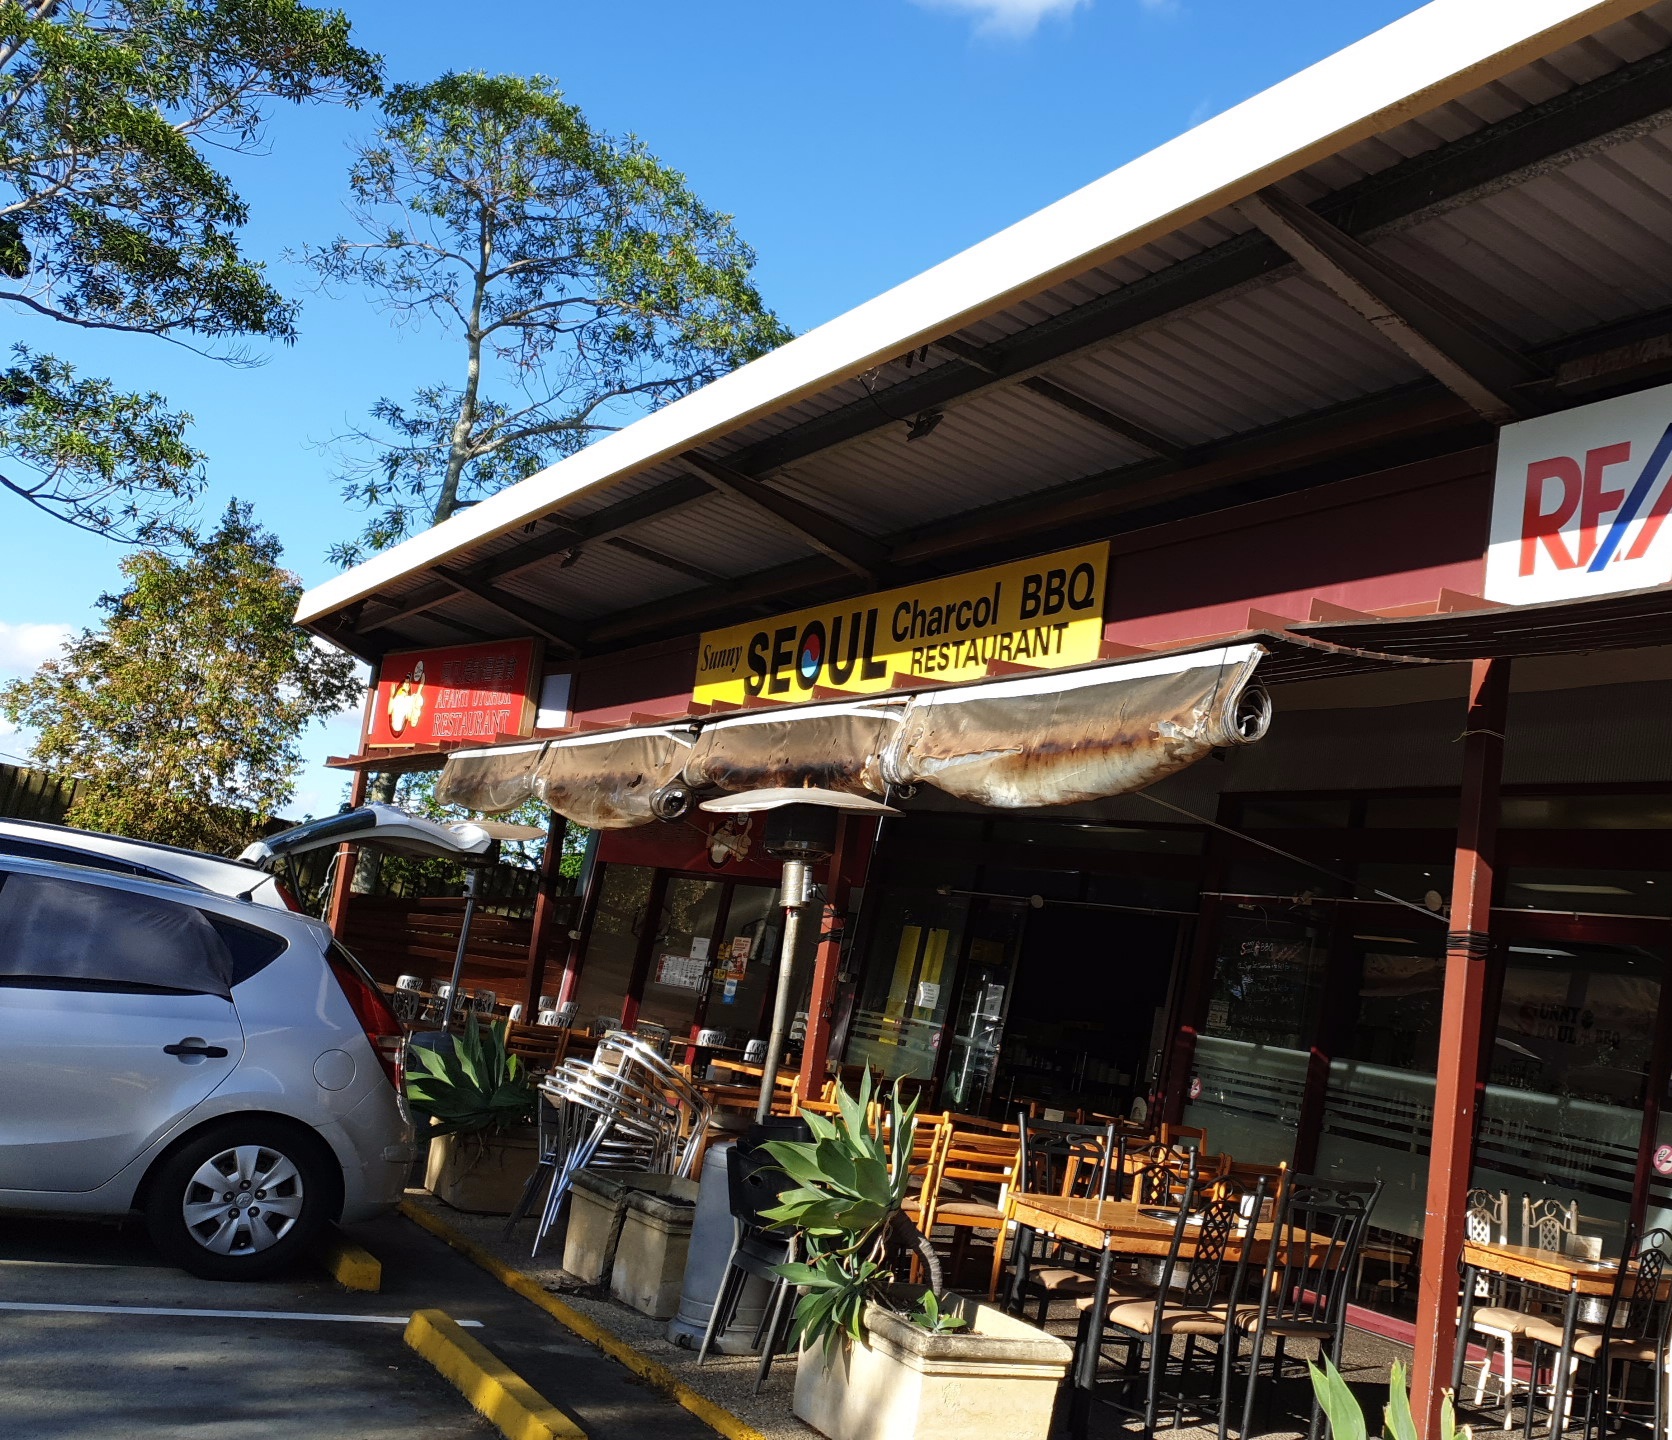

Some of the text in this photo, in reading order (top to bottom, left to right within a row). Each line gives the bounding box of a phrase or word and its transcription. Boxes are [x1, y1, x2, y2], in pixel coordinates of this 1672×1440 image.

[700, 562, 1096, 697] Sunny SEOUL Charcol BBQ
[910, 622, 1070, 675] RESTAURANT
[432, 710, 511, 737] RESTAURANT
